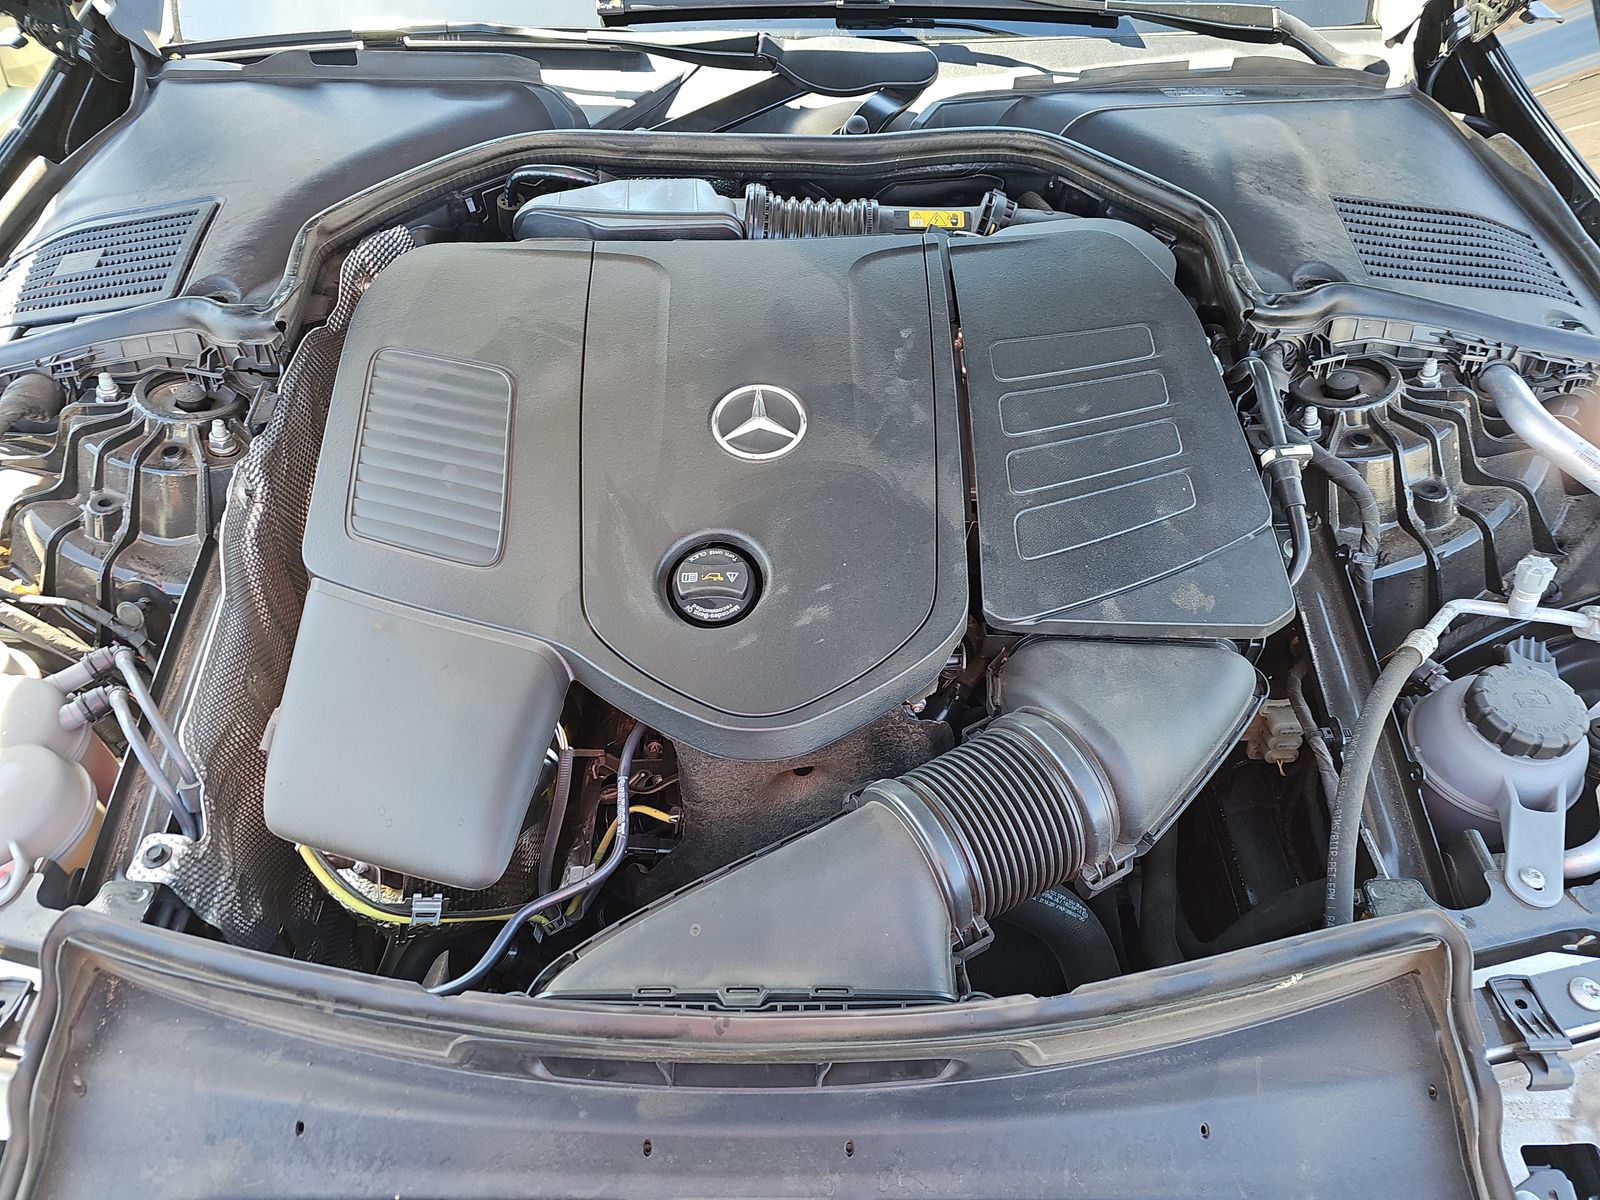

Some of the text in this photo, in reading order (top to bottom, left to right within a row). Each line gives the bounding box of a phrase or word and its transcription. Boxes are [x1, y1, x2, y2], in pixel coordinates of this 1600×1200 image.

[688, 551, 707, 562] CLICK
[724, 552, 738, 562] Turn
[692, 604, 741, 619] Mercedes-Benz
